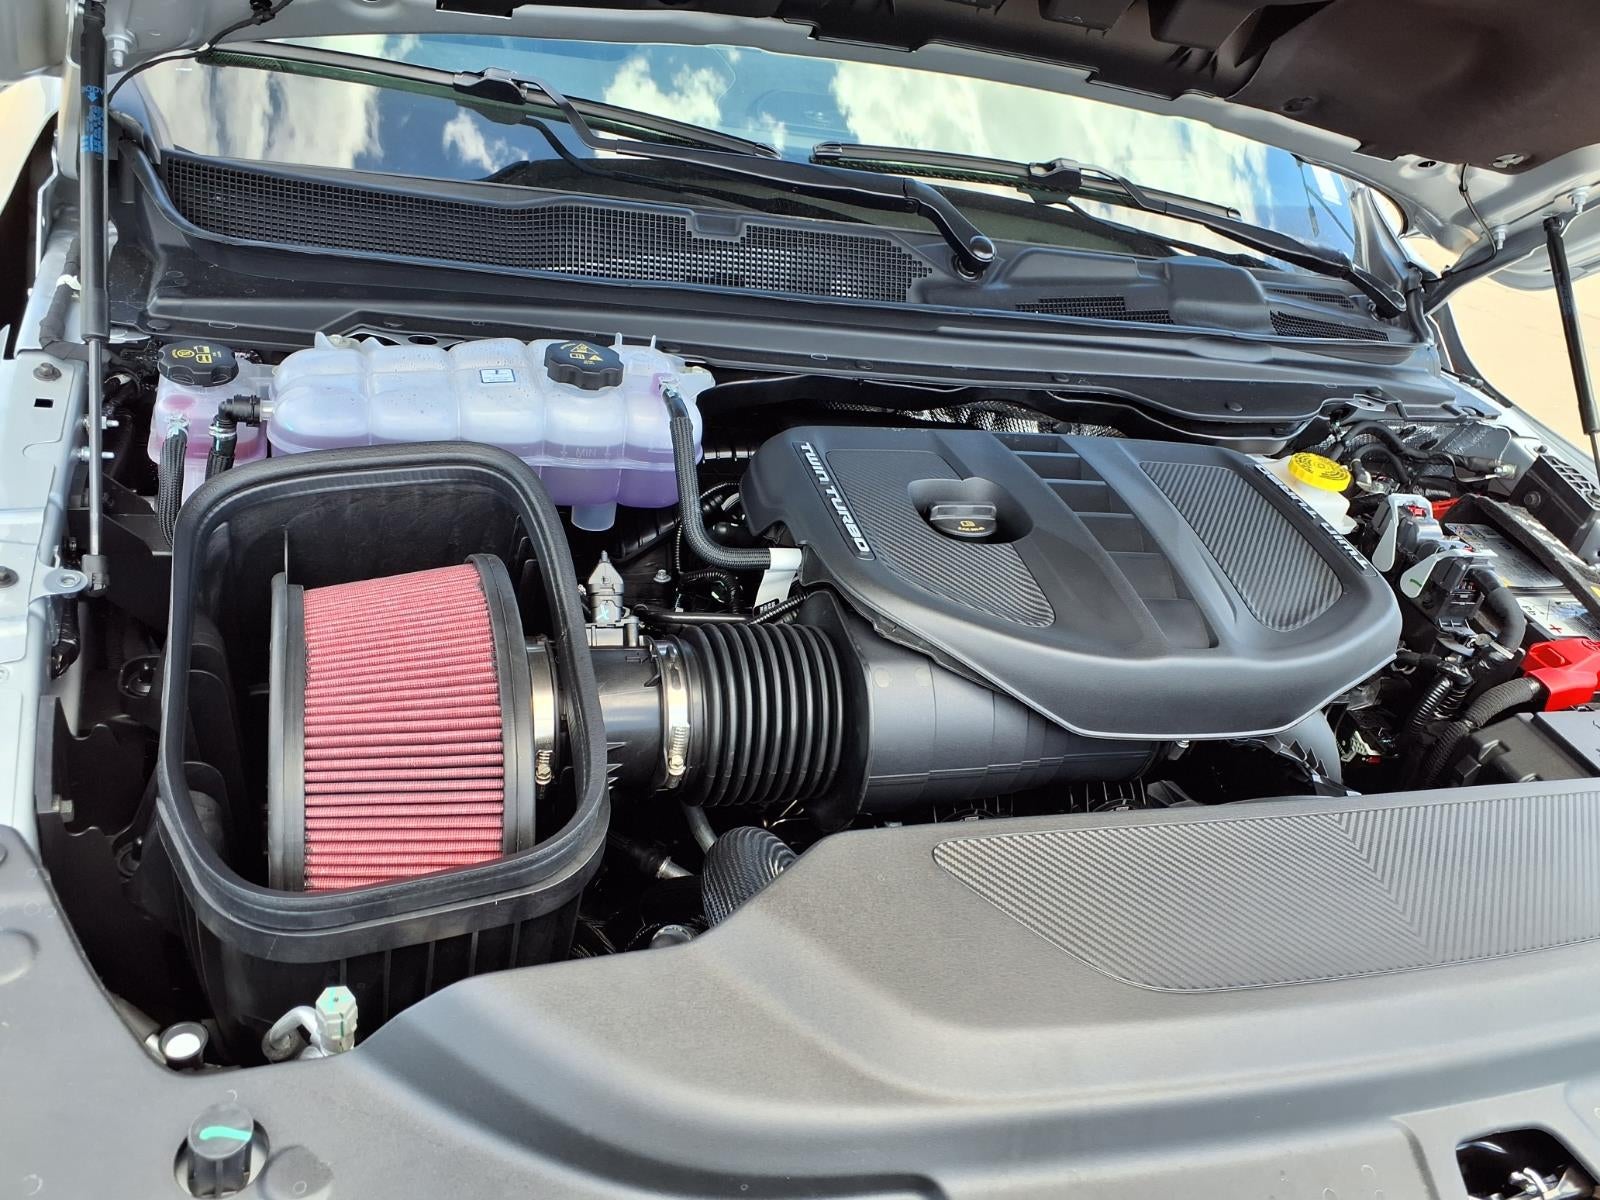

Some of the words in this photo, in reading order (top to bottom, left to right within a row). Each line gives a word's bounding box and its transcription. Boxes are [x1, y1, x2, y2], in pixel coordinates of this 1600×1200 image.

[576, 447, 597, 457] MIN
[801, 442, 829, 484] TWIN
[826, 485, 870, 552] TURBO
